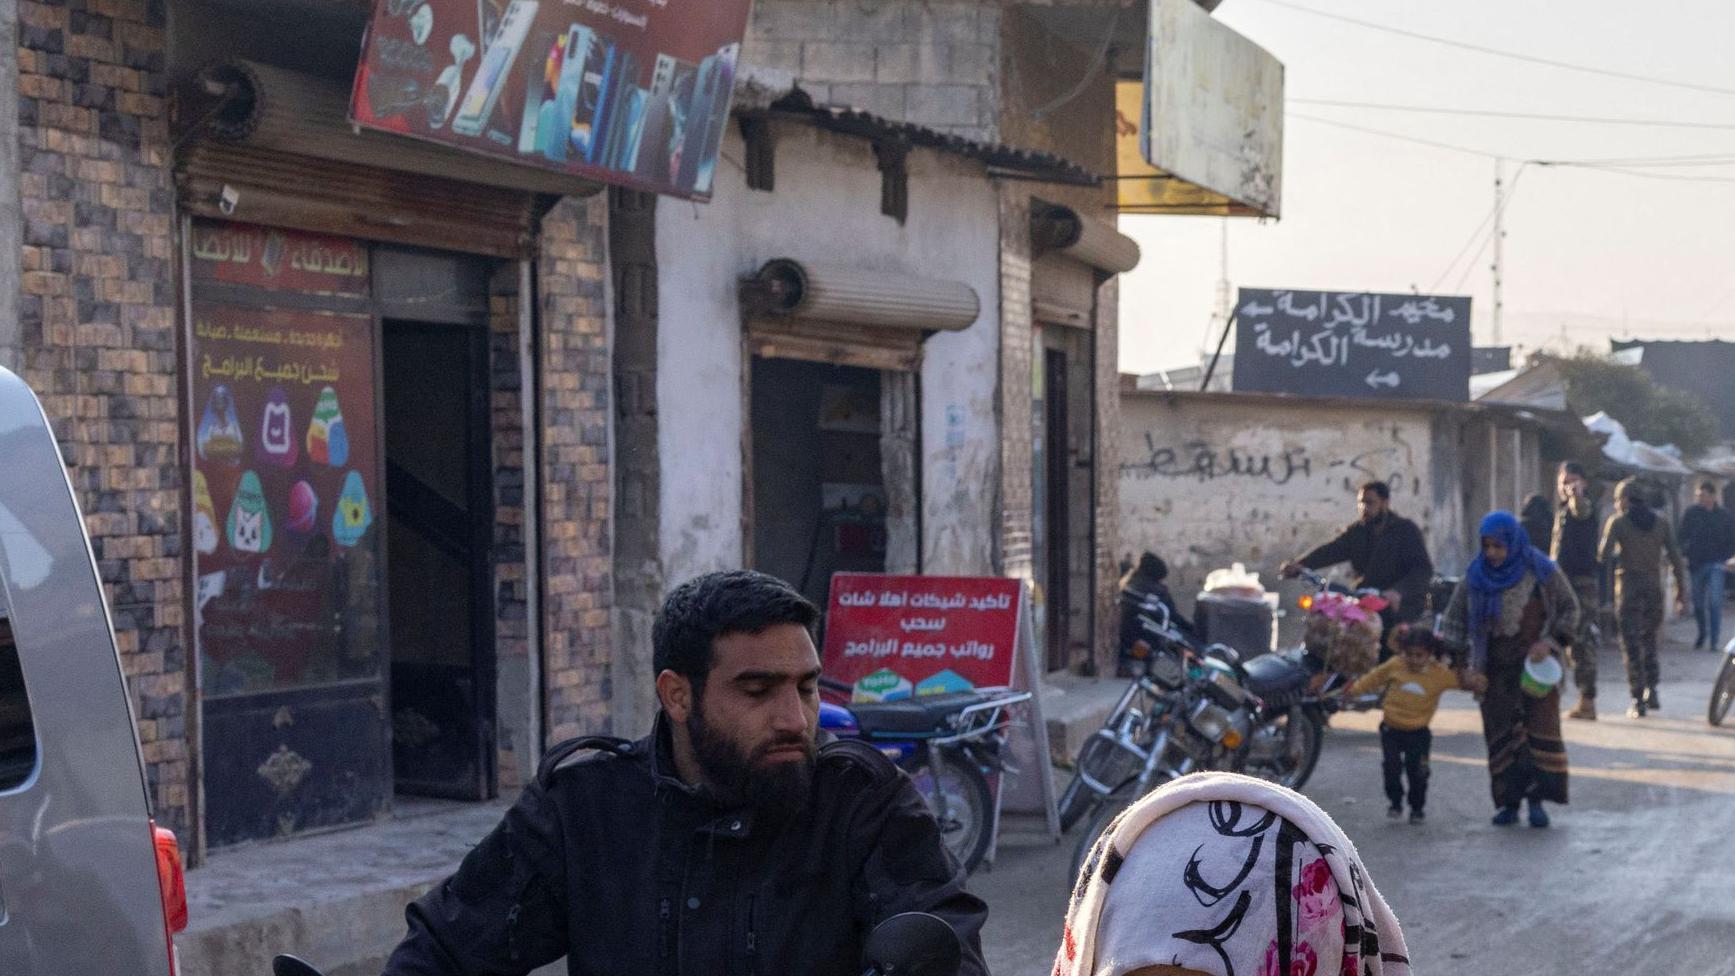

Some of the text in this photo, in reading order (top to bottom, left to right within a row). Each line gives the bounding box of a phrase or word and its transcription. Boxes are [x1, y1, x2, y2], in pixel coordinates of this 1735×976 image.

[1272, 290, 1382, 329] الكرامة
[1253, 322, 1452, 367] مدرسة الكرامة
